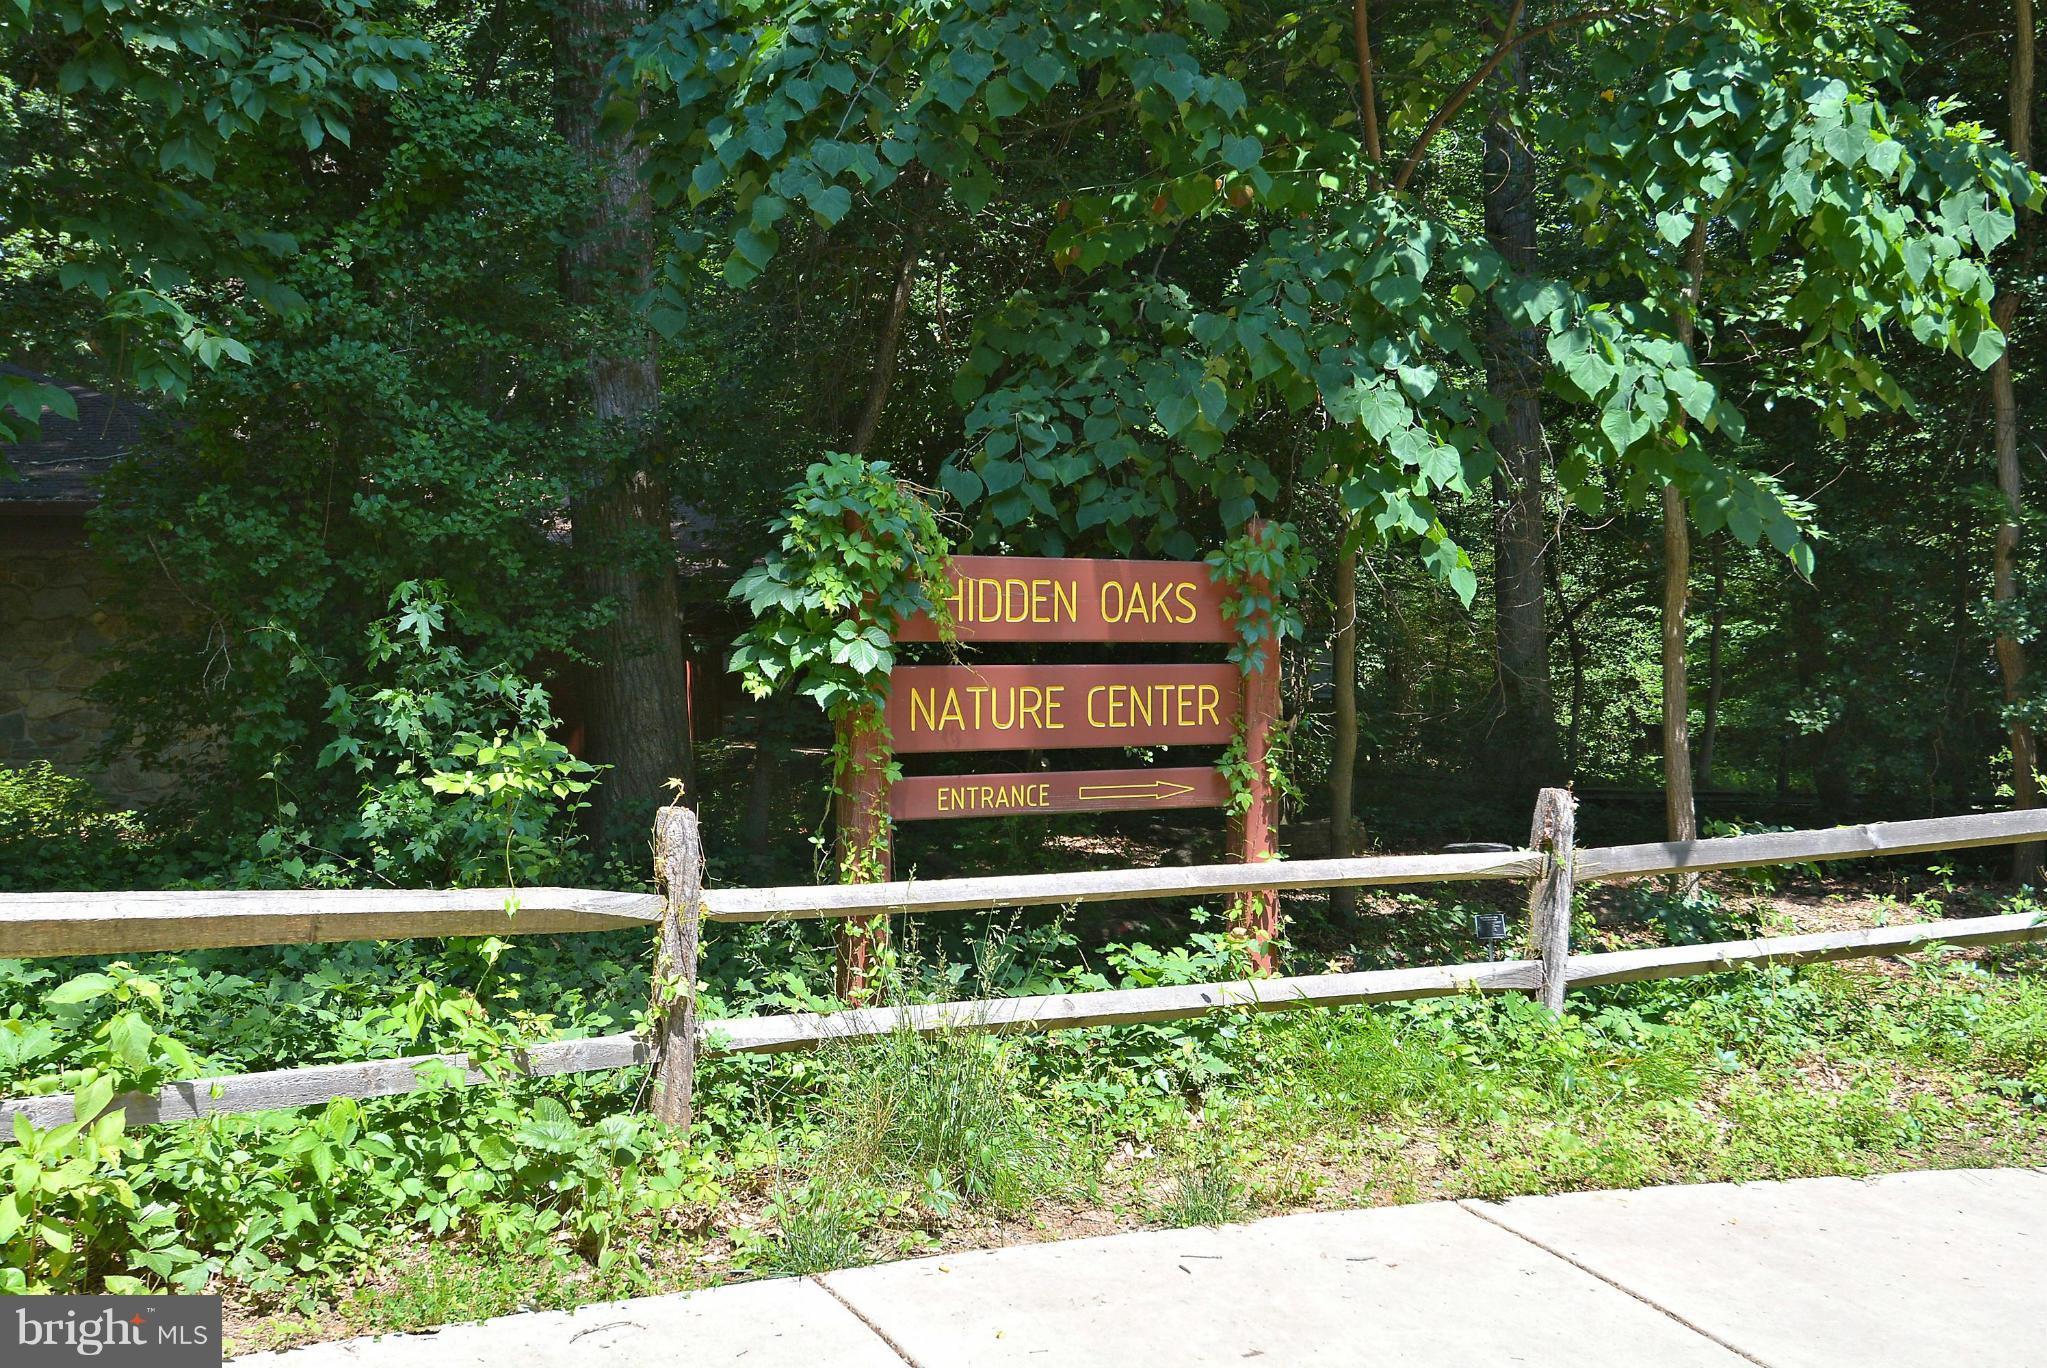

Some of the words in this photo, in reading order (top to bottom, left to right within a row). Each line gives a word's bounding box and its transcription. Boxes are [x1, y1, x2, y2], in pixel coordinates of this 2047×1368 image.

[1101, 581, 1197, 624] OAKS
[910, 686, 1065, 732] NATURE
[1088, 684, 1220, 728] CENTER
[937, 784, 1050, 811] ENTRANCE
